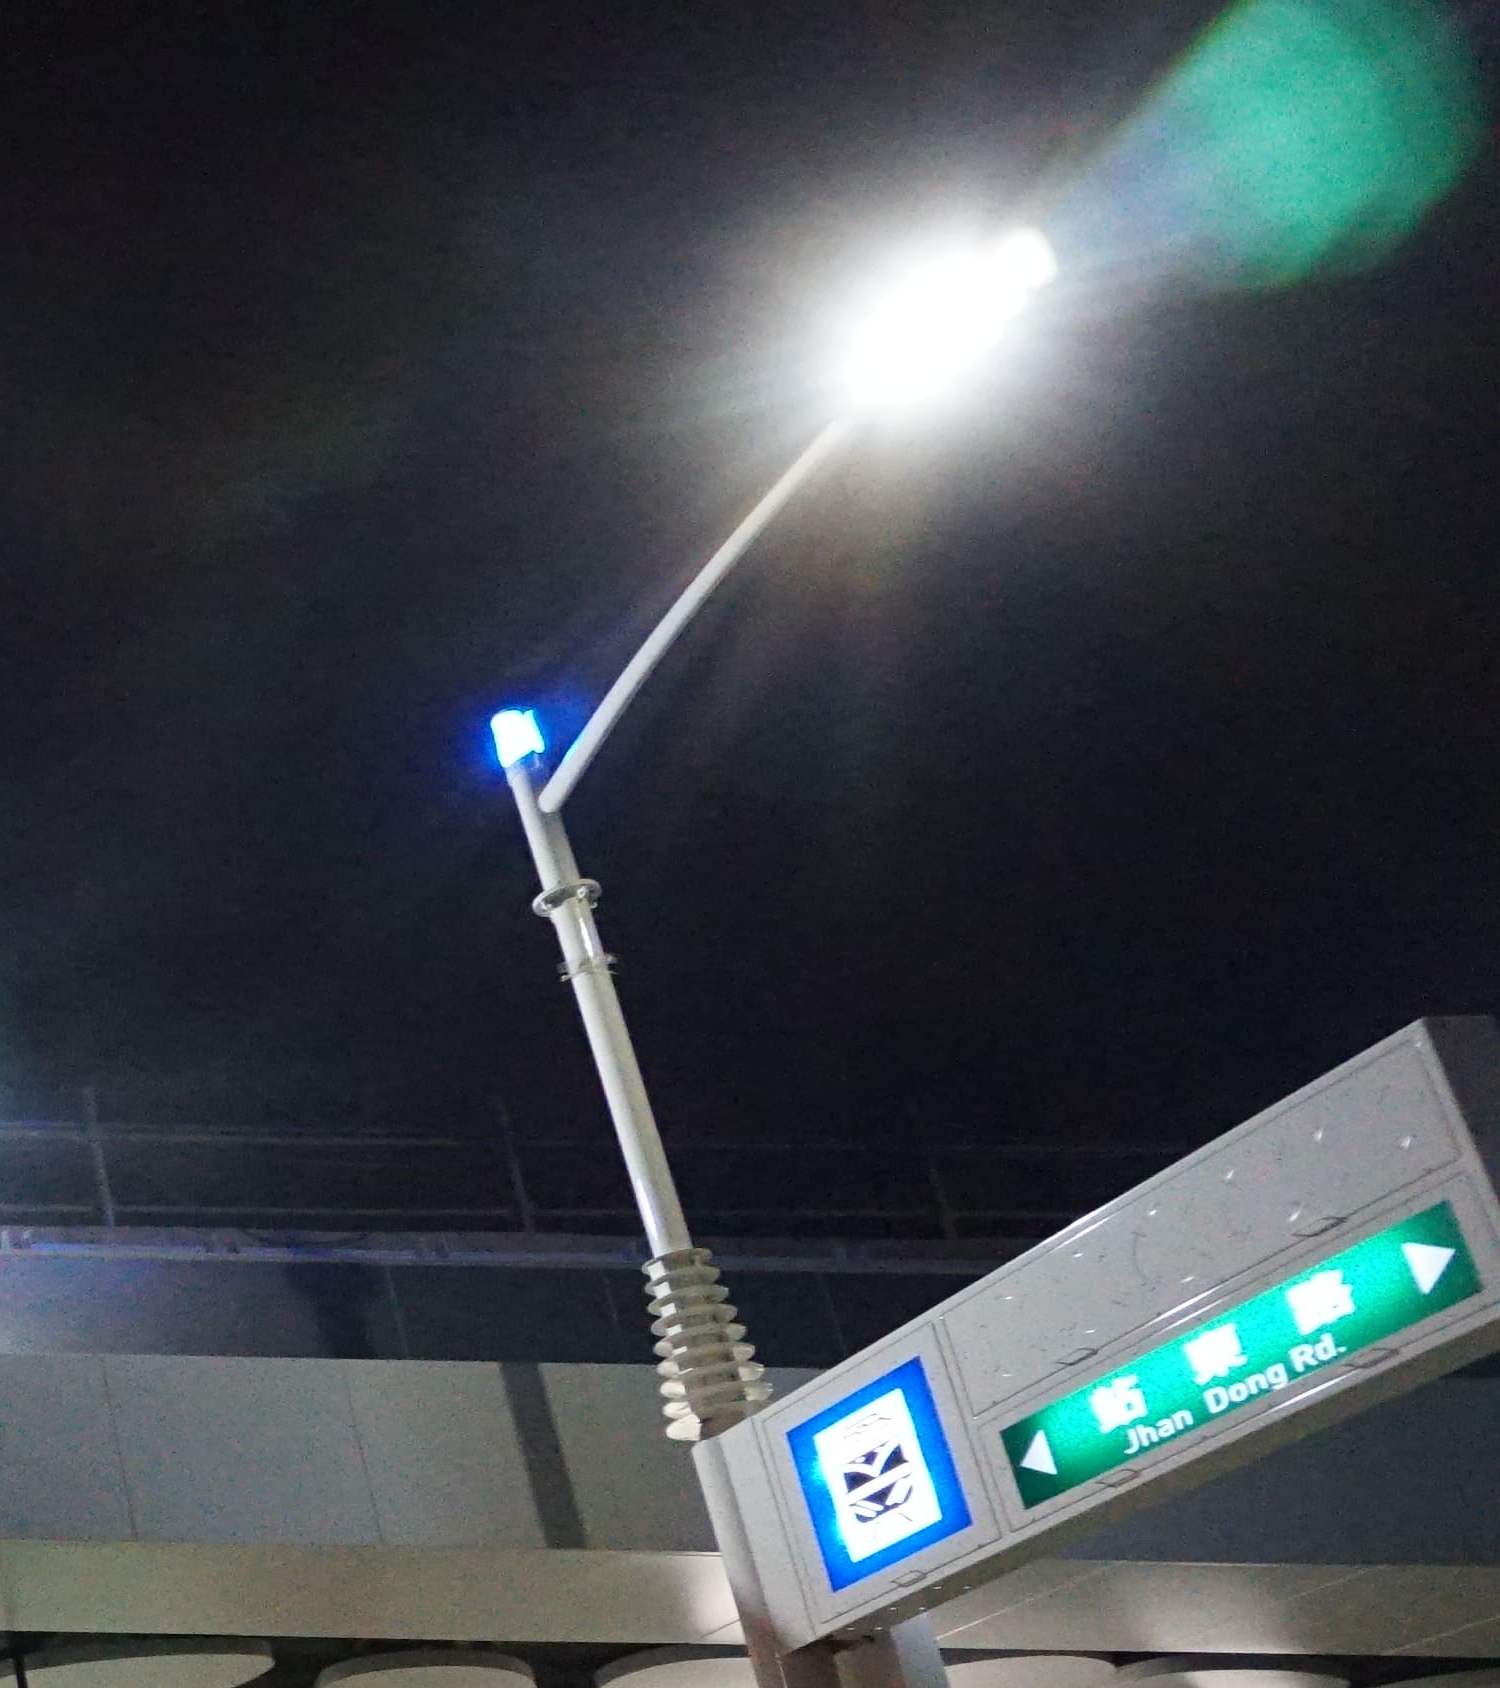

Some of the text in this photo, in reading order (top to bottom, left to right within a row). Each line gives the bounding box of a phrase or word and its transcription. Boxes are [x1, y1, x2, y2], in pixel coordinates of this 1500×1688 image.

[1124, 1333, 1348, 1454] Jhan Dong Rd.
